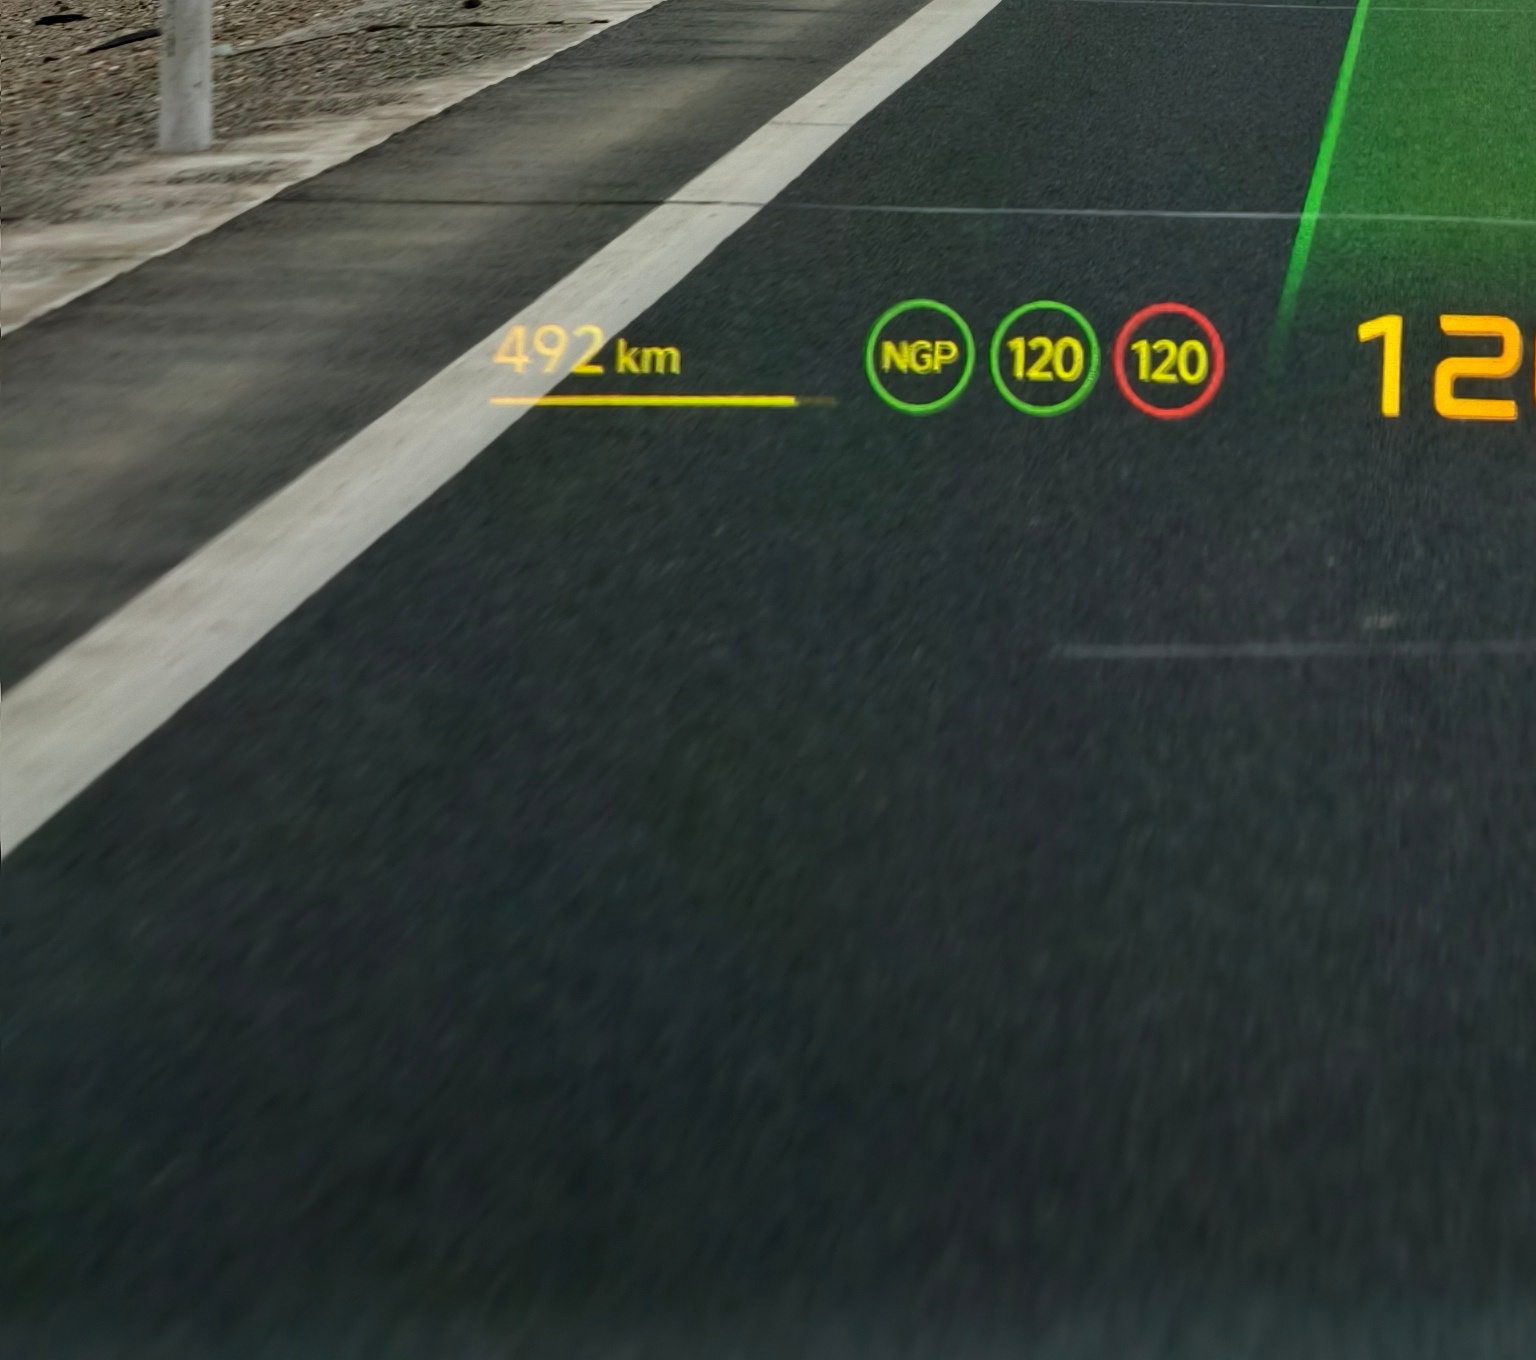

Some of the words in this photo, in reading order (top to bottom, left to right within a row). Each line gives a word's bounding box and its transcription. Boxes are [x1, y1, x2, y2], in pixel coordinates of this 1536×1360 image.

[492, 323, 604, 376] 492
[614, 339, 683, 375] km
[880, 339, 957, 374] NGP
[1007, 336, 1082, 382] 120
[1132, 338, 1207, 384] 120
